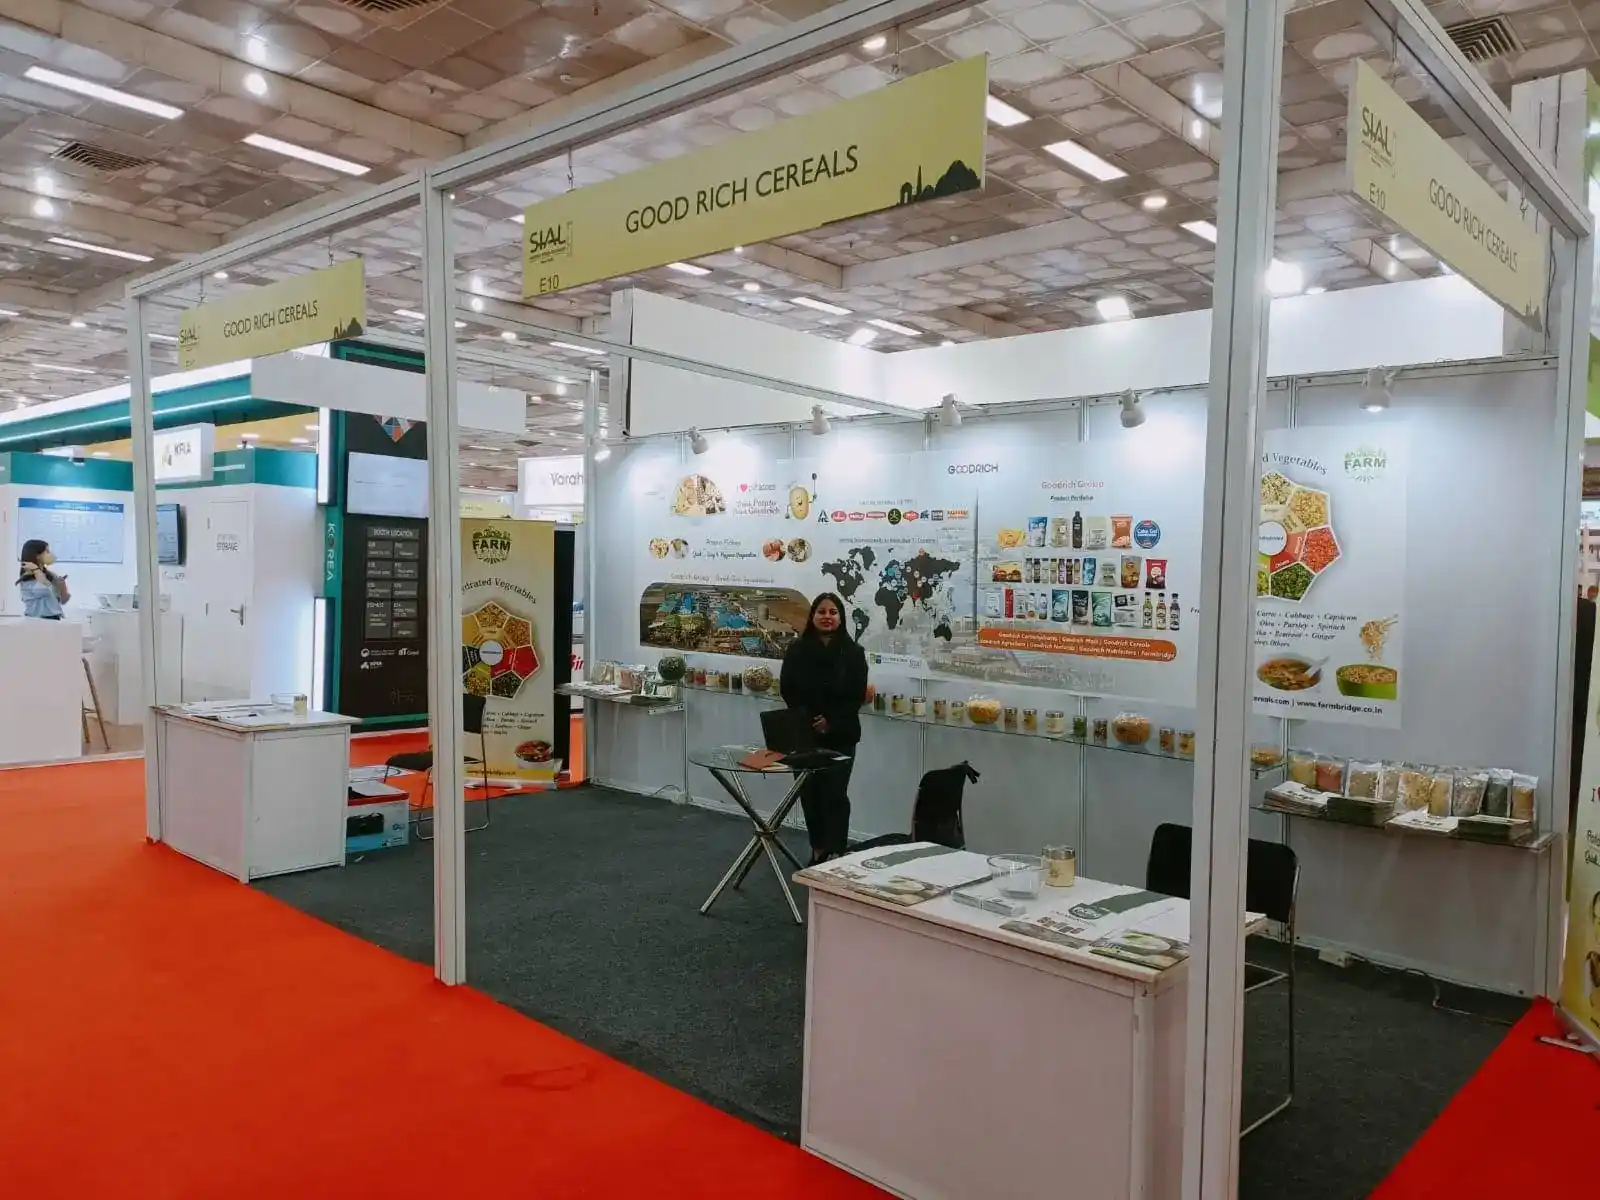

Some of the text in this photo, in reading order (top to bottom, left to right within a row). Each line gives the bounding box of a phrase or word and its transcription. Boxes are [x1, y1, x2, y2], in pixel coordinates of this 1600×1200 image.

[1362, 106, 1391, 157] SIAL
[626, 144, 859, 234] GOOD RICH CEREALS
[1369, 182, 1386, 210] E10
[1429, 178, 1518, 273] GOOD RICH CEREALS
[529, 223, 566, 254] SIAL
[540, 274, 559, 292] E10
[223, 299, 318, 338] GOOD RICH CEREALS
[179, 325, 198, 345] SIAL
[947, 463, 999, 475] GOODRICH
[1272, 452, 1328, 476] Vegetables
[1344, 457, 1386, 470] FARM
[550, 471, 584, 487] Varah
[326, 522, 337, 581] KOREA
[472, 539, 511, 553] FARM
[494, 577, 537, 604] Vegetables
[1296, 700, 1383, 714] www.farmbridge.co.in
